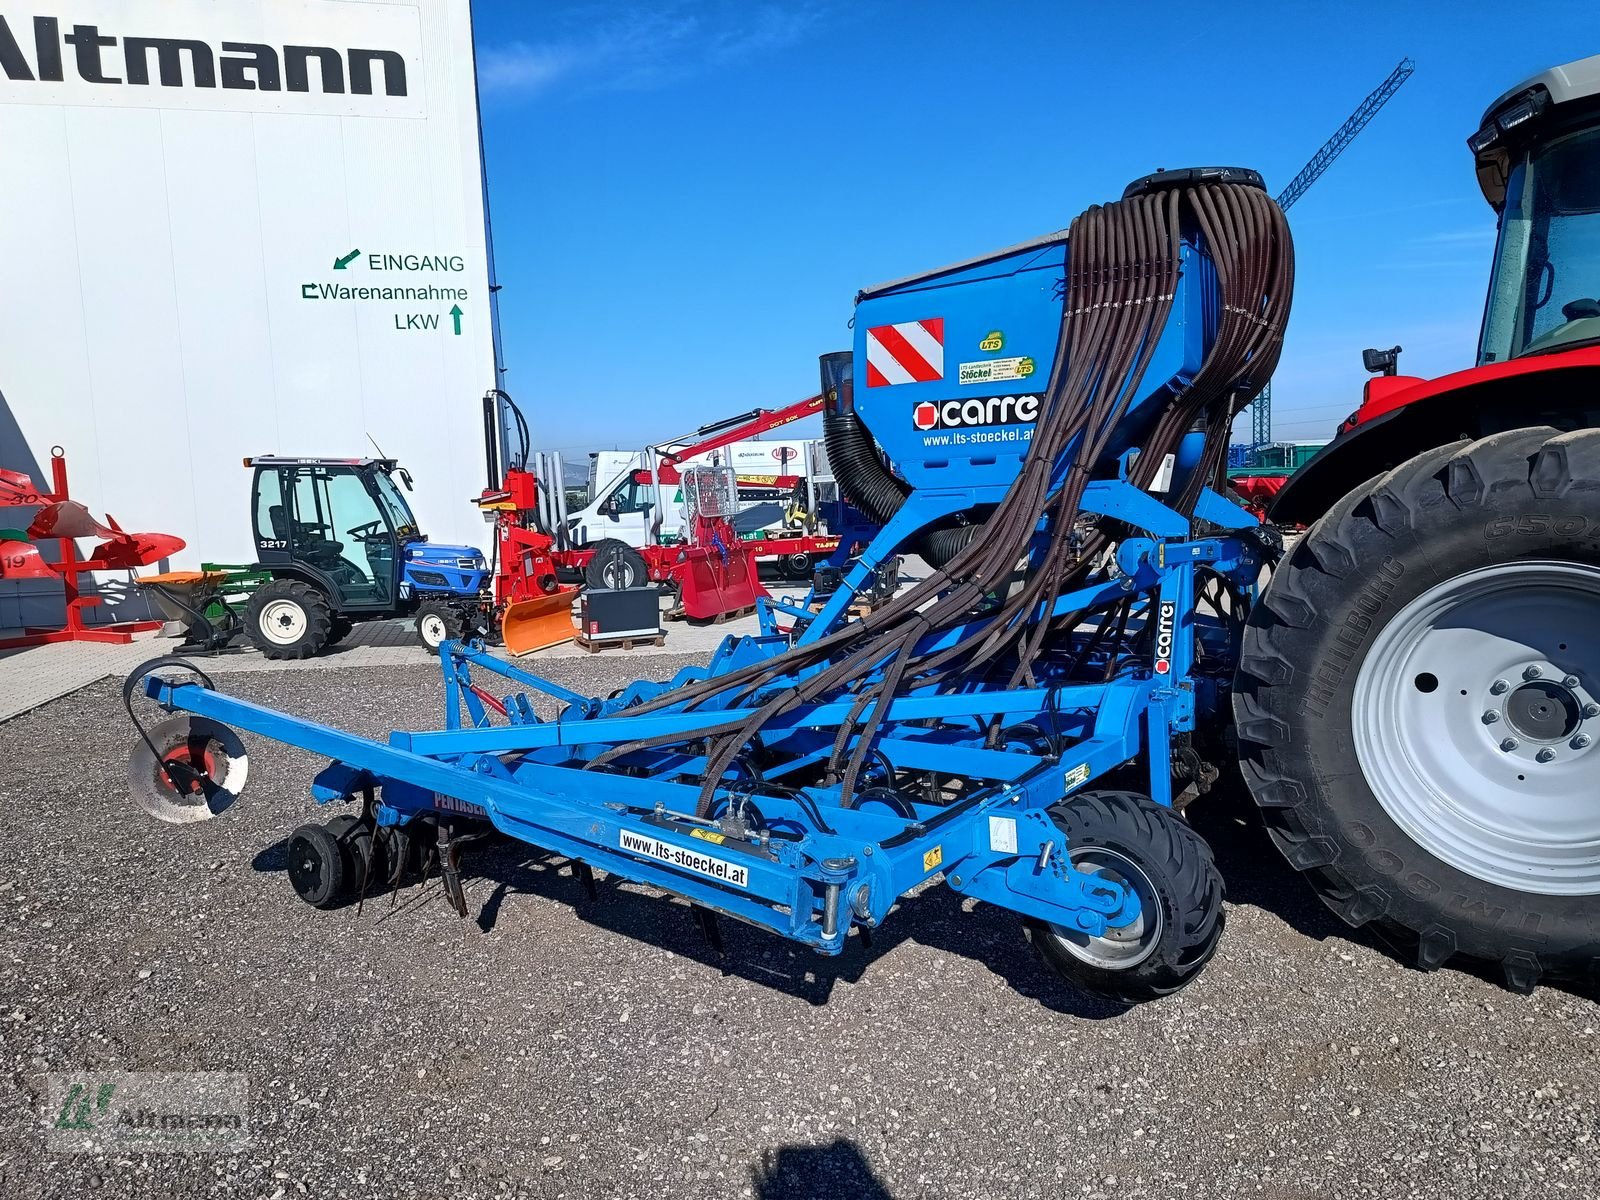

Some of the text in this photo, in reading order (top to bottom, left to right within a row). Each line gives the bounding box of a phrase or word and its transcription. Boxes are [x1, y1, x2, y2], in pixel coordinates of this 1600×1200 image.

[368, 254, 465, 272] EINGANG
[318, 283, 469, 301] Warenannahme
[394, 313, 440, 330] LKW
[981, 340, 1000, 350] LTS
[1016, 366, 1032, 374] LTS
[941, 395, 1040, 427] carre
[923, 428, 1035, 447] www.lts-stoeckel.at
[260, 540, 288, 549] 3217
[814, 541, 840, 549] TAJFU
[4, 555, 26, 569] 19
[1296, 554, 1405, 720] TRELLEBORG
[622, 833, 746, 885] www.lts-stoeckel.at
